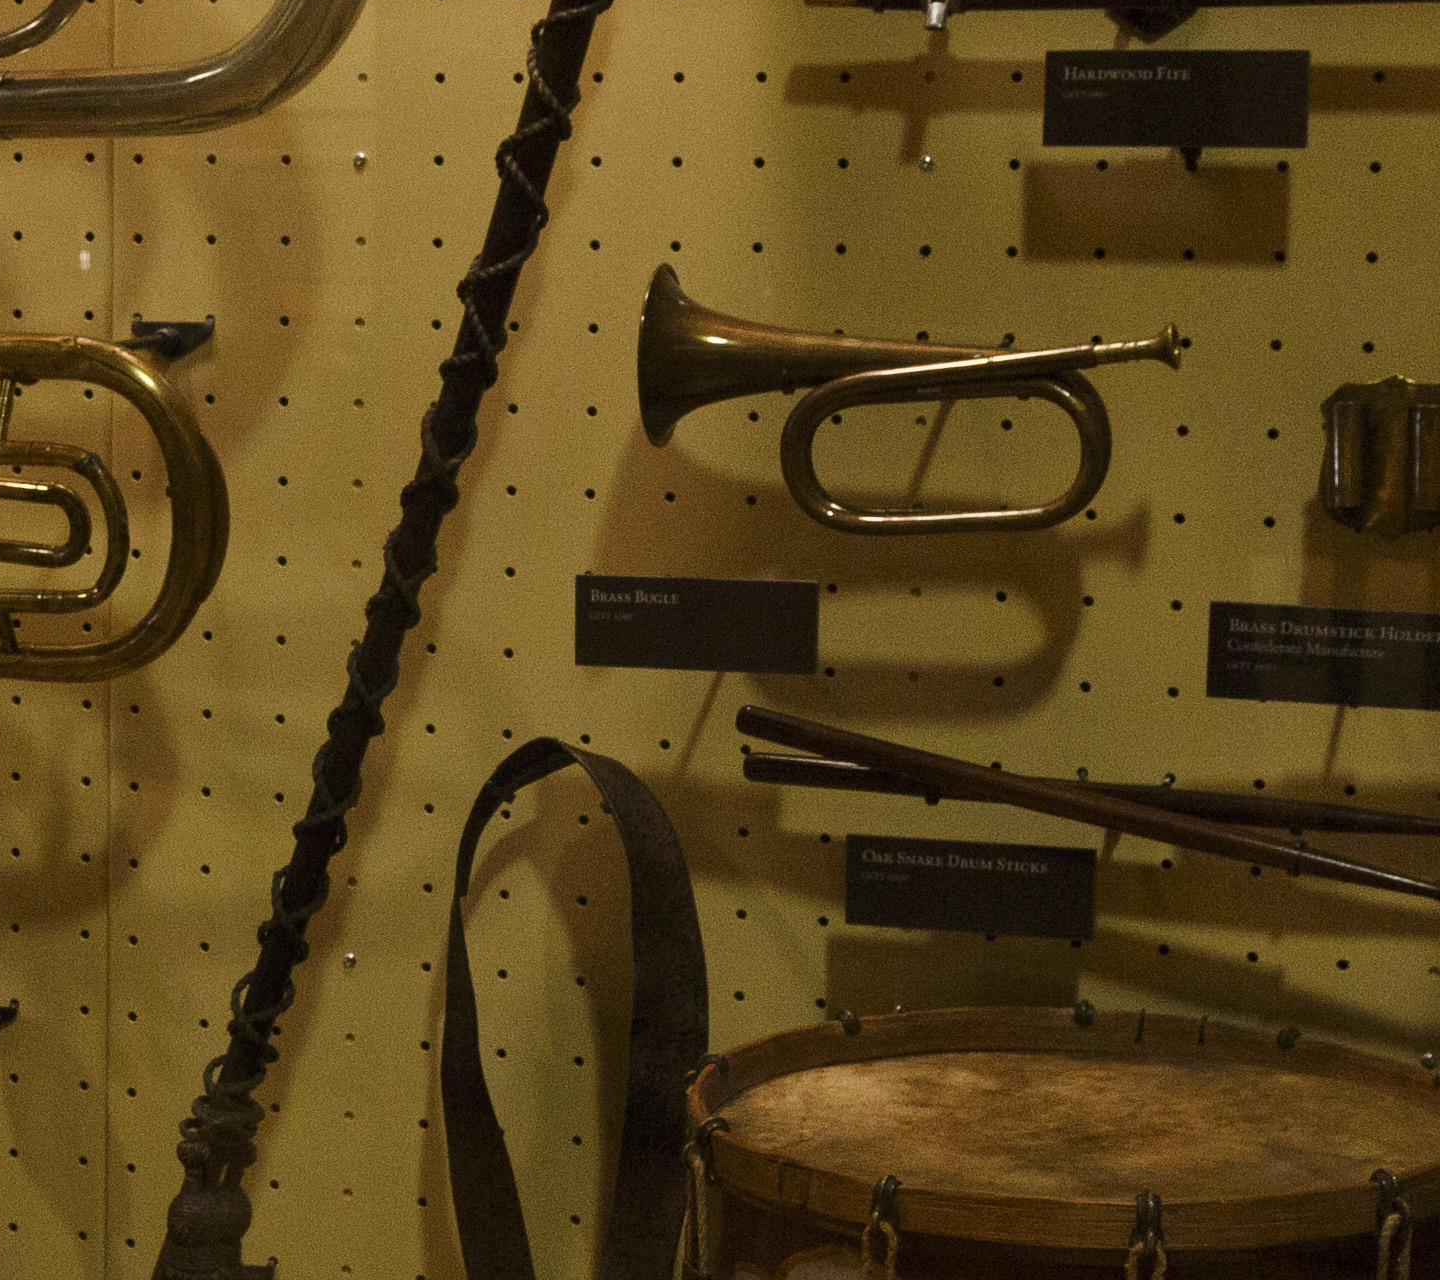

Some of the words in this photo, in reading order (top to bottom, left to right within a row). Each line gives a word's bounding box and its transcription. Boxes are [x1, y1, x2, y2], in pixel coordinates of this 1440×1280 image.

[1063, 66, 1154, 81] HARDWOOD
[1155, 65, 1191, 81] FIFE
[590, 588, 631, 603] BRASS
[634, 589, 679, 604] BUGLE
[1228, 618, 1277, 634] BRASS
[1280, 621, 1375, 639] DRUMSTICK
[1227, 639, 1303, 656] Confederate
[1306, 641, 1387, 658] Manufacture
[861, 849, 894, 864] OAK
[896, 851, 944, 867] SNARE
[947, 854, 993, 871] DRUM
[996, 857, 1049, 874] STICKS
